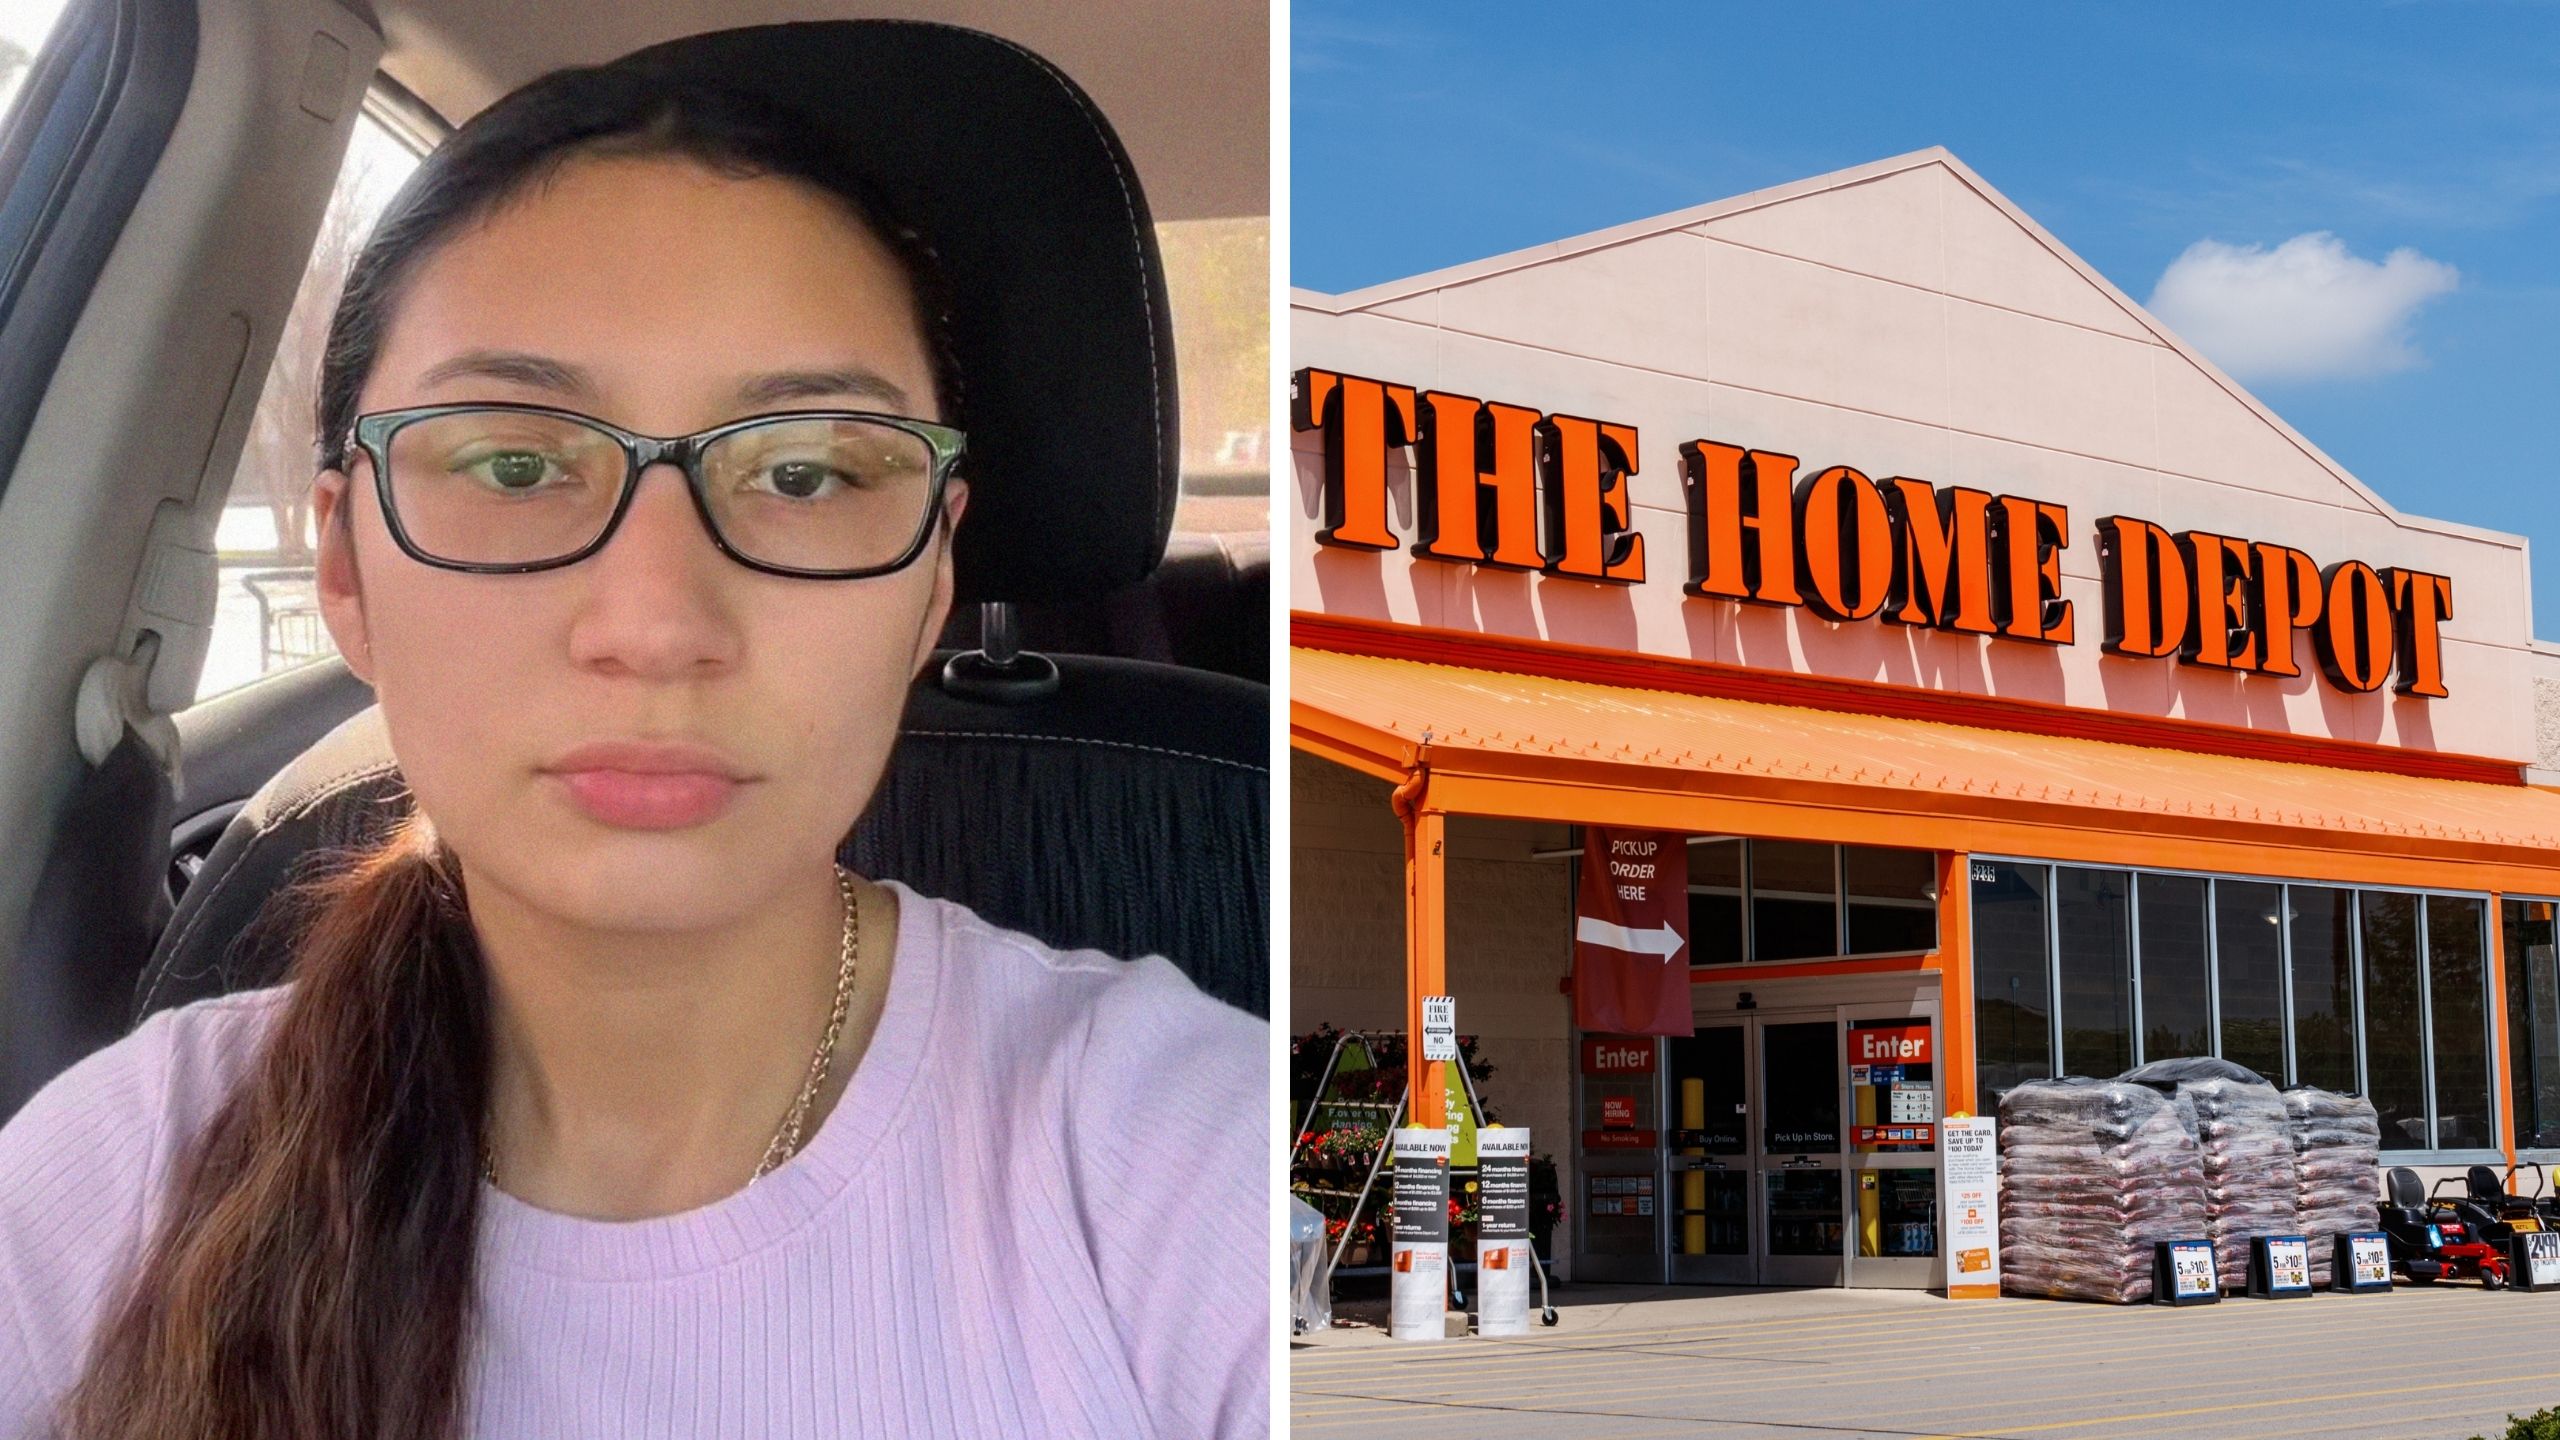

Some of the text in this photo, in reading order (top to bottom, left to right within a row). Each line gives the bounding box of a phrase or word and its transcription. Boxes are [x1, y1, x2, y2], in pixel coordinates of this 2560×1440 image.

[1293, 366, 2453, 698] THE HOME DEPOT
[1611, 840, 1657, 856] PICKUP
[1610, 861, 1655, 879] ORDER
[1617, 884, 1646, 901] HERE
[1429, 1005, 1448, 1013] FIRE
[1429, 1015, 1448, 1023] LANE
[1433, 1036, 1444, 1044] NO
[1863, 1034, 1925, 1059] Enter
[1596, 1046, 1649, 1069] Enter
[1604, 1101, 1622, 1109] NOW
[1604, 1109, 1630, 1118] HIRING
[1775, 1132, 1835, 1142] Pick Up In Store.
[1974, 1129, 1992, 1137] CARD,
[1601, 1134, 1640, 1144] No Smoking
[1699, 1134, 1738, 1145] Buy Online.
[1429, 1144, 1446, 1152] NOW
[1481, 1143, 1519, 1151] AVAILABLE
[1481, 1164, 1491, 1172] 24
[1481, 1180, 1491, 1188] 12
[2273, 1256, 2279, 1268] 5
[2356, 1252, 2362, 1265] 5
[2177, 1262, 2183, 1275] 5
